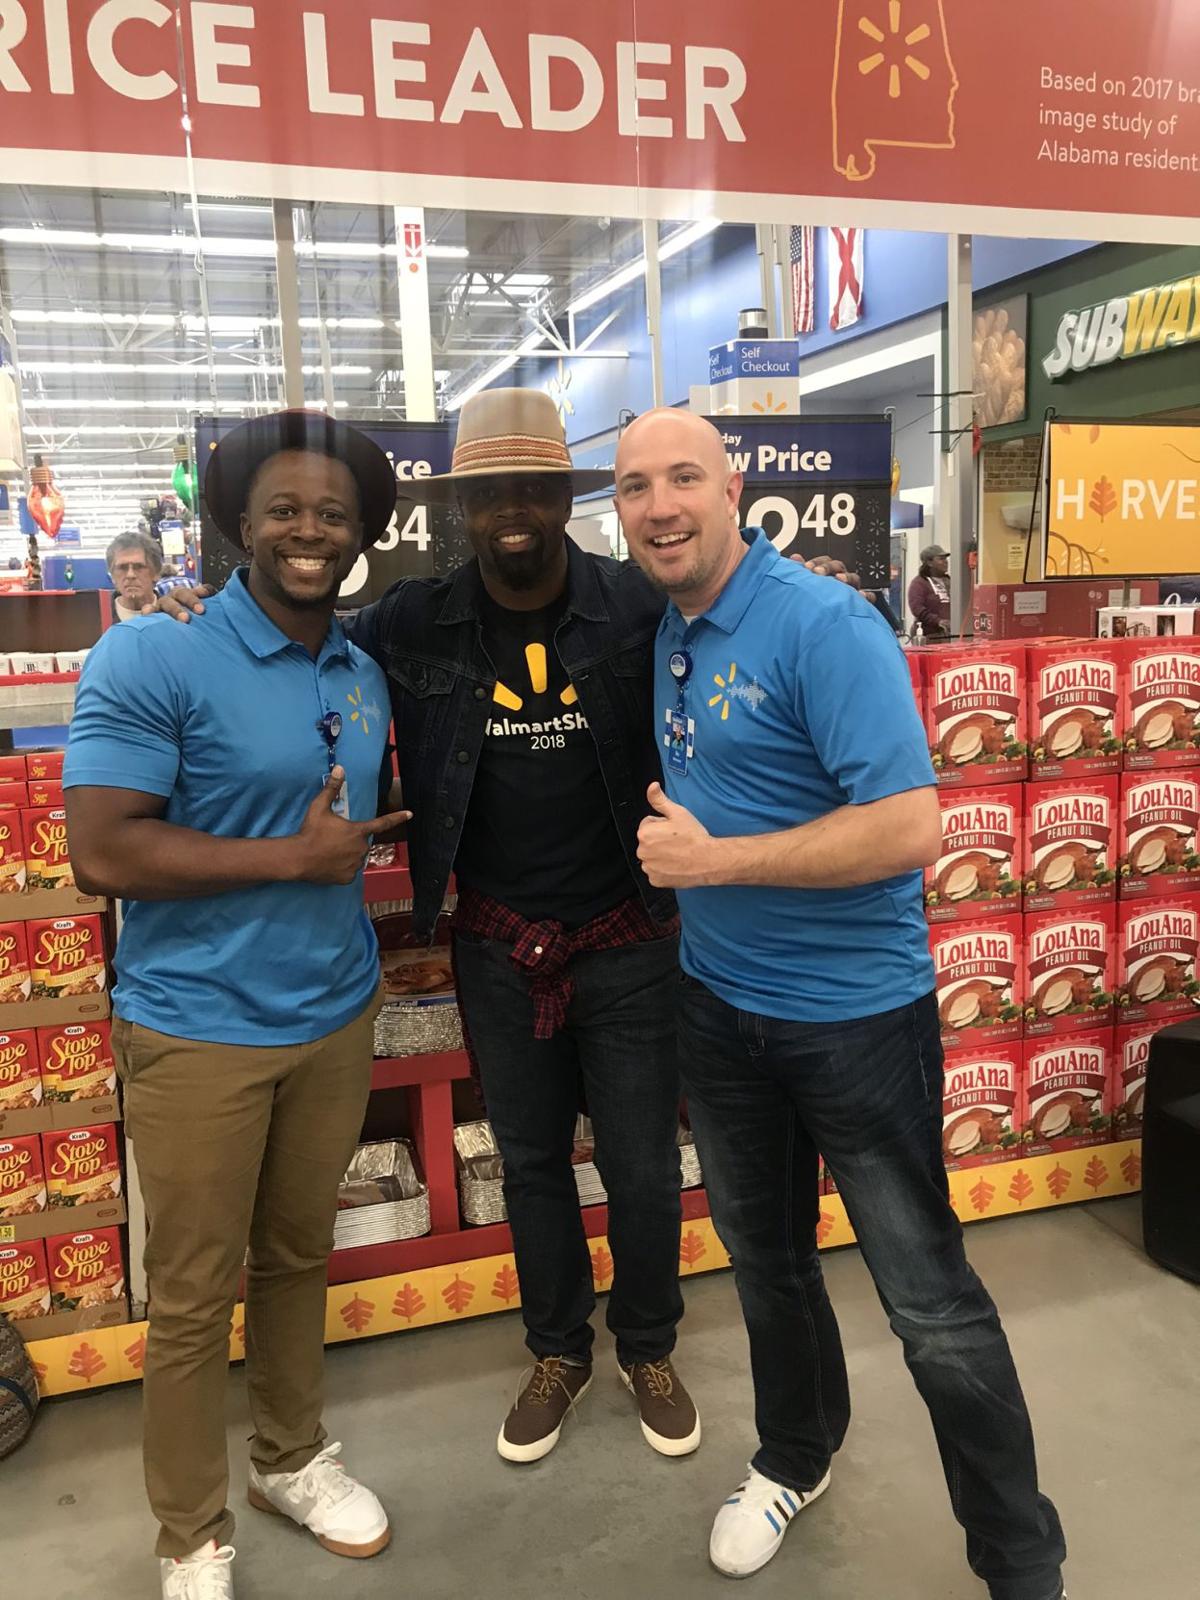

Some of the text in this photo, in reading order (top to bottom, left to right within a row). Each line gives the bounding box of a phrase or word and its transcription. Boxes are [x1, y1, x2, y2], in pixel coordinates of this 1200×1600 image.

[303, 12, 747, 142] LEADER
[1041, 66, 1096, 93] Based
[1103, 79, 1125, 96] on
[1131, 76, 1173, 100] 2017
[1039, 103, 1178, 140] image study of
[1037, 139, 1200, 172] Alabama resident
[741, 347, 760, 358] Self
[711, 365, 733, 379] Checkout
[741, 361, 790, 372] Checkout
[758, 444, 832, 472] Price
[941, 668, 1012, 698] LouAna
[1045, 664, 1111, 695] LouAna
[1055, 691, 1100, 705] PEANUT OIL
[1146, 684, 1190, 697] PEANUT OIL
[952, 695, 1000, 711] PEANUT OIL
[530, 734, 566, 749] 2018
[1131, 785, 1193, 814] LouAna
[1037, 799, 1104, 829] LouAna
[1141, 809, 1182, 824] PEANUT OIL
[948, 834, 996, 849] PEANUT OIL
[1047, 825, 1092, 840] PEANUT OIL
[1131, 914, 1191, 943] LouAna
[35, 929, 92, 964] Stove
[1036, 925, 1100, 955] LouAna
[1139, 938, 1181, 953] PEANUT OIL
[54, 949, 85, 971] Top
[939, 936, 1008, 966] LouAna
[1045, 951, 1089, 966] PEANUT OIL
[950, 963, 996, 978] PEANUT OIL
[46, 1034, 102, 1070] Stove
[65, 1054, 96, 1075] Top
[1034, 1050, 1099, 1079] LouAna
[1044, 1074, 1088, 1090] PEANUT OIL
[952, 1091, 997, 1107] PEANUT OIL
[51, 1138, 107, 1175] Stove
[70, 1159, 101, 1180] Top
[55, 1241, 111, 1278] Stove
[76, 1261, 104, 1282] Top
